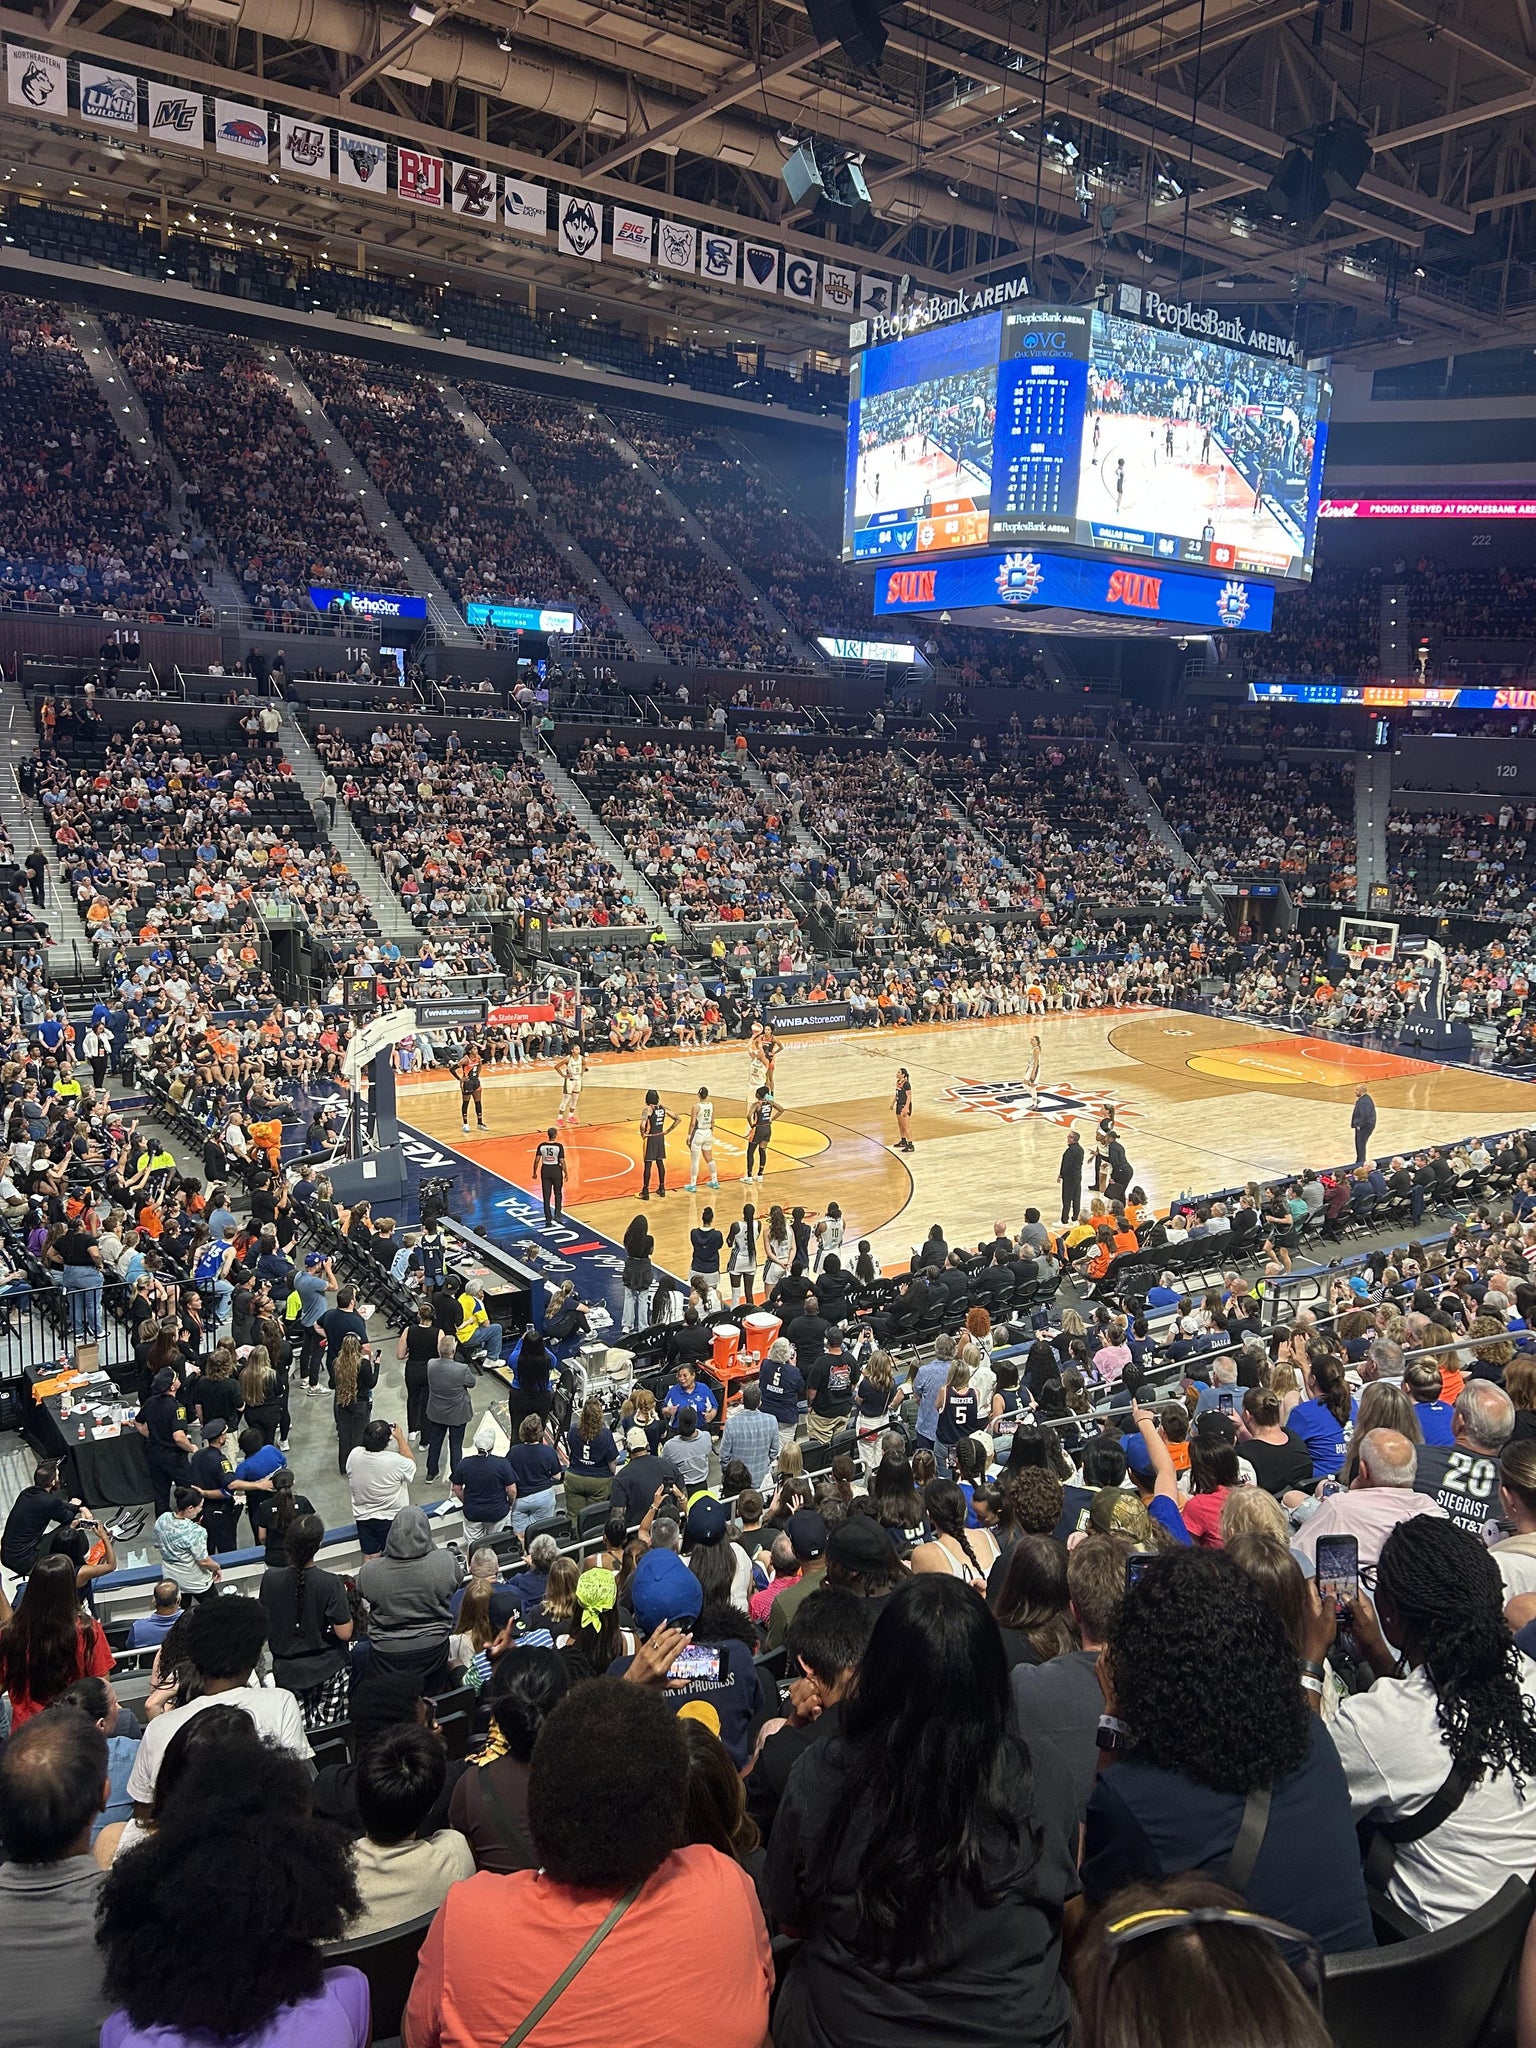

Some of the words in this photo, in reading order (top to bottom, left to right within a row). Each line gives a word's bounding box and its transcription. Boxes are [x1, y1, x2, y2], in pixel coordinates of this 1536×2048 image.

[13, 51, 61, 70] NORTHEASTERN
[88, 90, 135, 114] UNH
[87, 105, 133, 121] WILDCATS
[152, 99, 198, 131] MC
[285, 134, 325, 158] MASS
[340, 136, 387, 162] MAINE
[399, 149, 443, 196] BU
[523, 205, 546, 215] HOCKEY
[523, 210, 537, 218] EAST
[621, 222, 645, 234] BIG
[617, 230, 650, 244] EAST
[787, 261, 813, 298] G
[971, 276, 1029, 312] ARENA
[1016, 312, 1062, 326] PeoplesBank
[1062, 315, 1086, 325] ARENA
[1146, 290, 1246, 344] PeoplesBank
[1248, 329, 1297, 358] ARENA
[1023, 331, 1067, 349] OVG
[1370, 505, 1409, 514] PROUDLY
[1410, 505, 1443, 514] SERVED
[1443, 505, 1456, 514] AT
[1456, 505, 1517, 514] PEOPLESBANK
[1518, 505, 1536, 514] ARE
[1002, 521, 1047, 533] PeoplesBank
[1047, 525, 1070, 533] ARENA
[1099, 527, 1123, 540] DALLAS
[1188, 541, 1202, 552] 2.9
[1472, 535, 1492, 546] 222
[1215, 548, 1230, 563] 83
[886, 570, 937, 604] SUN
[1106, 570, 1163, 610] SUN
[346, 647, 371, 661] 115
[834, 638, 864, 657] M&T
[868, 643, 900, 660] Bank
[760, 679, 776, 691] 117
[1496, 765, 1518, 777] 120
[428, 1008, 481, 1017] WNBAStore.com
[777, 1014, 846, 1028] WNBAStore.com
[654, 1109, 664, 1118] 42
[761, 1104, 771, 1113] 25
[545, 1147, 554, 1156] 15
[495, 1197, 580, 1243] ULTRA
[832, 1227, 839, 1238] 10
[428, 1250, 434, 1259] 5
[772, 1371, 781, 1386] 5
[955, 1406, 967, 1425] 5
[582, 1444, 590, 1460] 5
[1442, 1451, 1496, 1498] 20
[1436, 1489, 1490, 1519] SIEGRIST
[1452, 1515, 1485, 1534] AT&T
